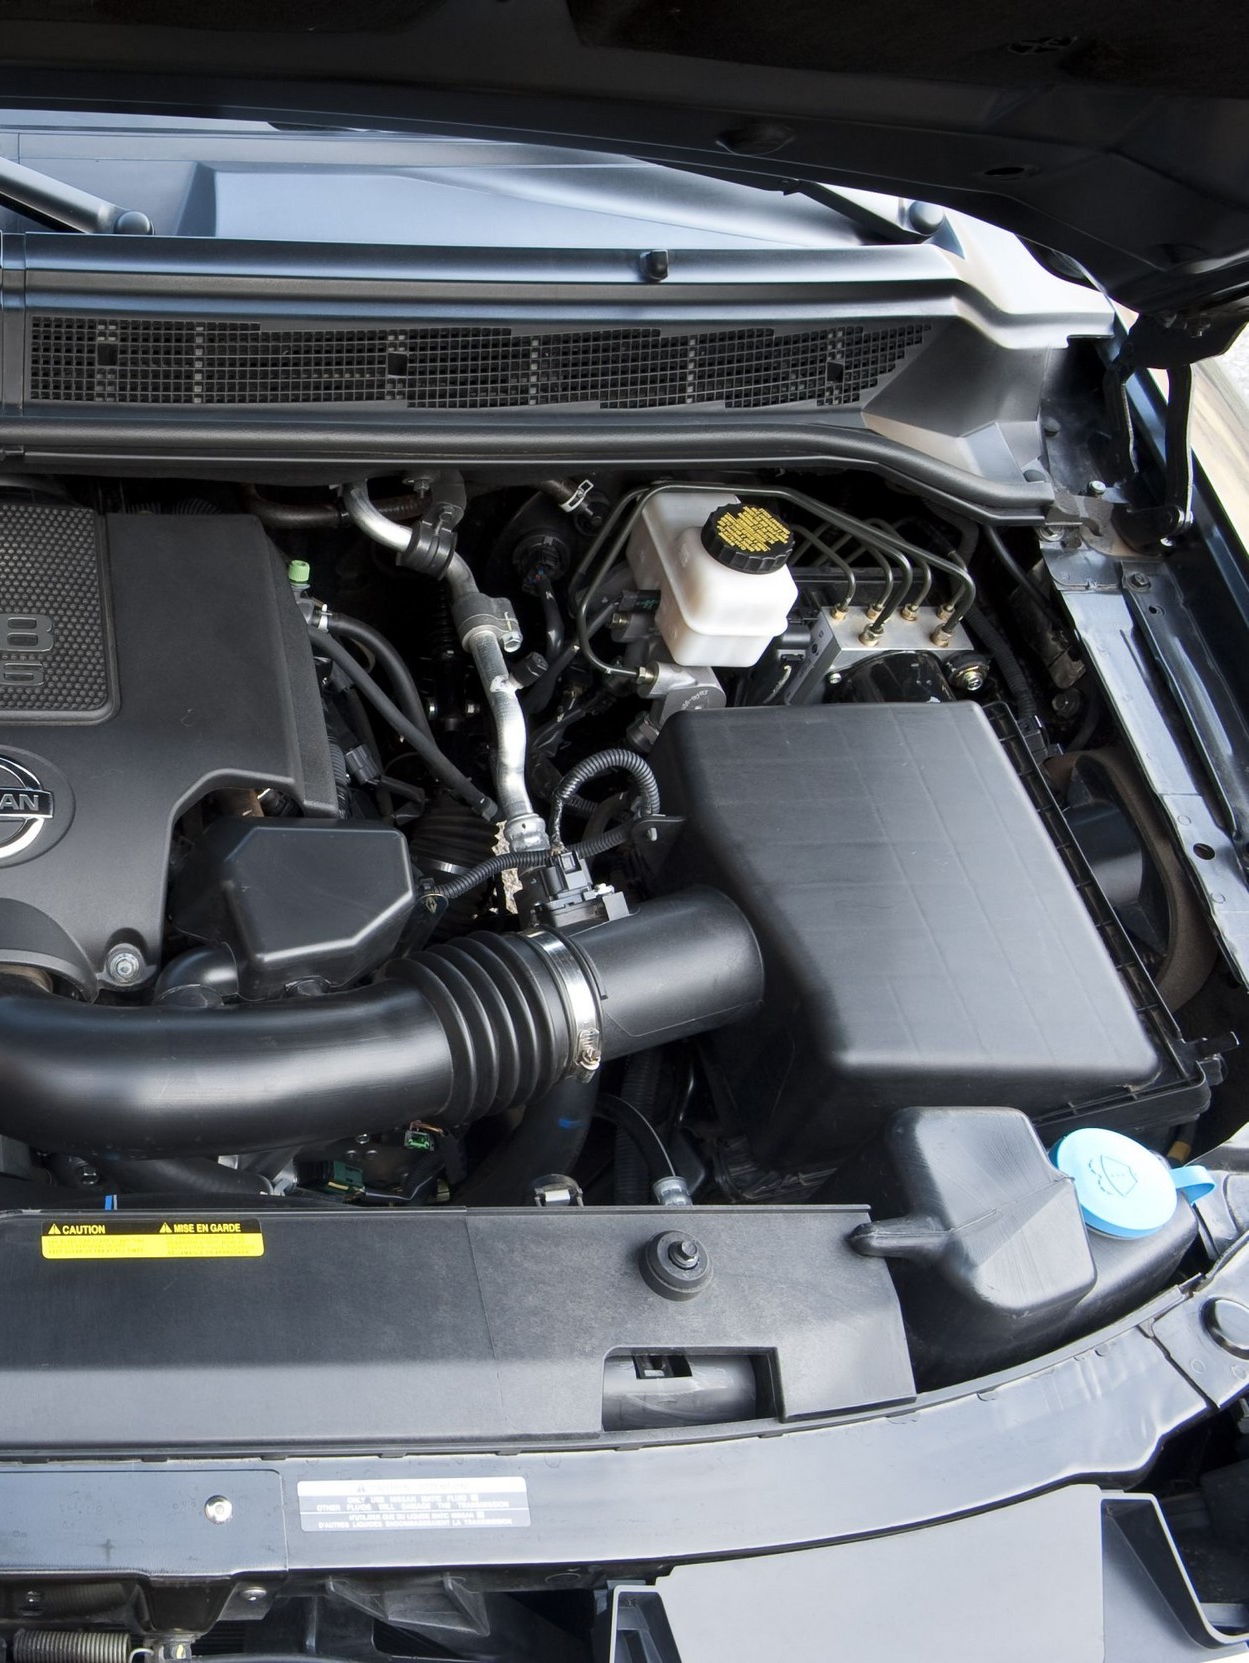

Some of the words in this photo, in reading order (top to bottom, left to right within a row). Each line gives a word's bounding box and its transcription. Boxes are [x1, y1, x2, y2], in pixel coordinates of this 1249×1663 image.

[62, 1225, 106, 1235] CAUTION
[173, 1224, 194, 1233] MISE
[196, 1224, 208, 1232] EN
[210, 1223, 241, 1233] GARDE
